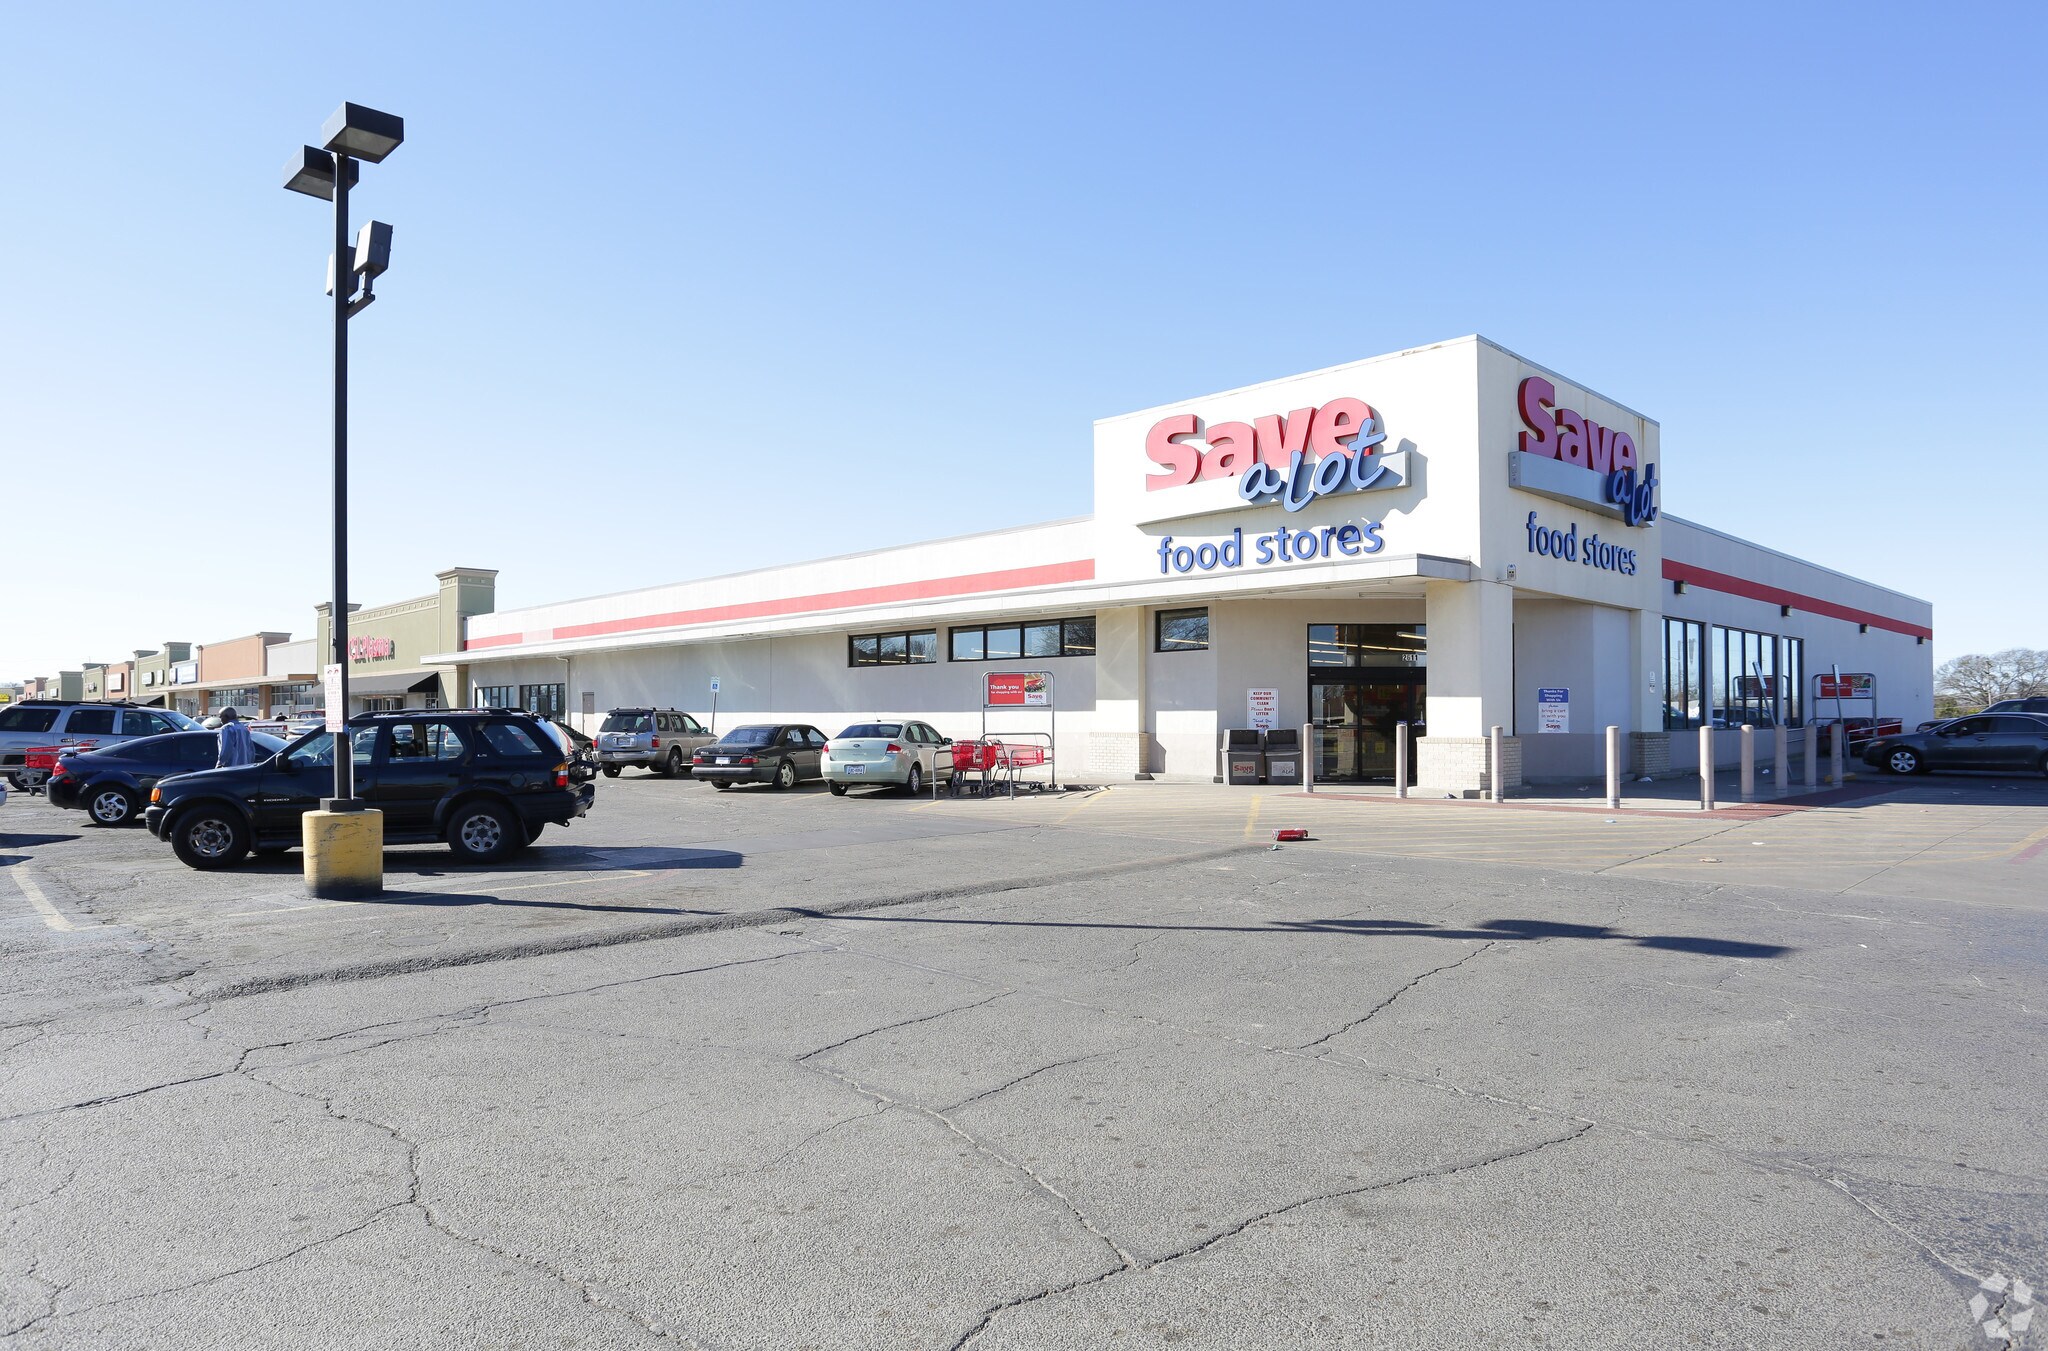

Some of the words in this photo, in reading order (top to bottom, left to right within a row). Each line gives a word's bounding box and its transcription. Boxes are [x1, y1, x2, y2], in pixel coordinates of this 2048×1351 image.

[1146, 397, 1375, 491] Save
[1518, 376, 1637, 472] Save
[1157, 527, 1242, 574] food
[1256, 521, 1384, 565] stores
[1526, 511, 1577, 562] food
[1582, 533, 1637, 575] stores
[362, 635, 391, 659] Plasma
